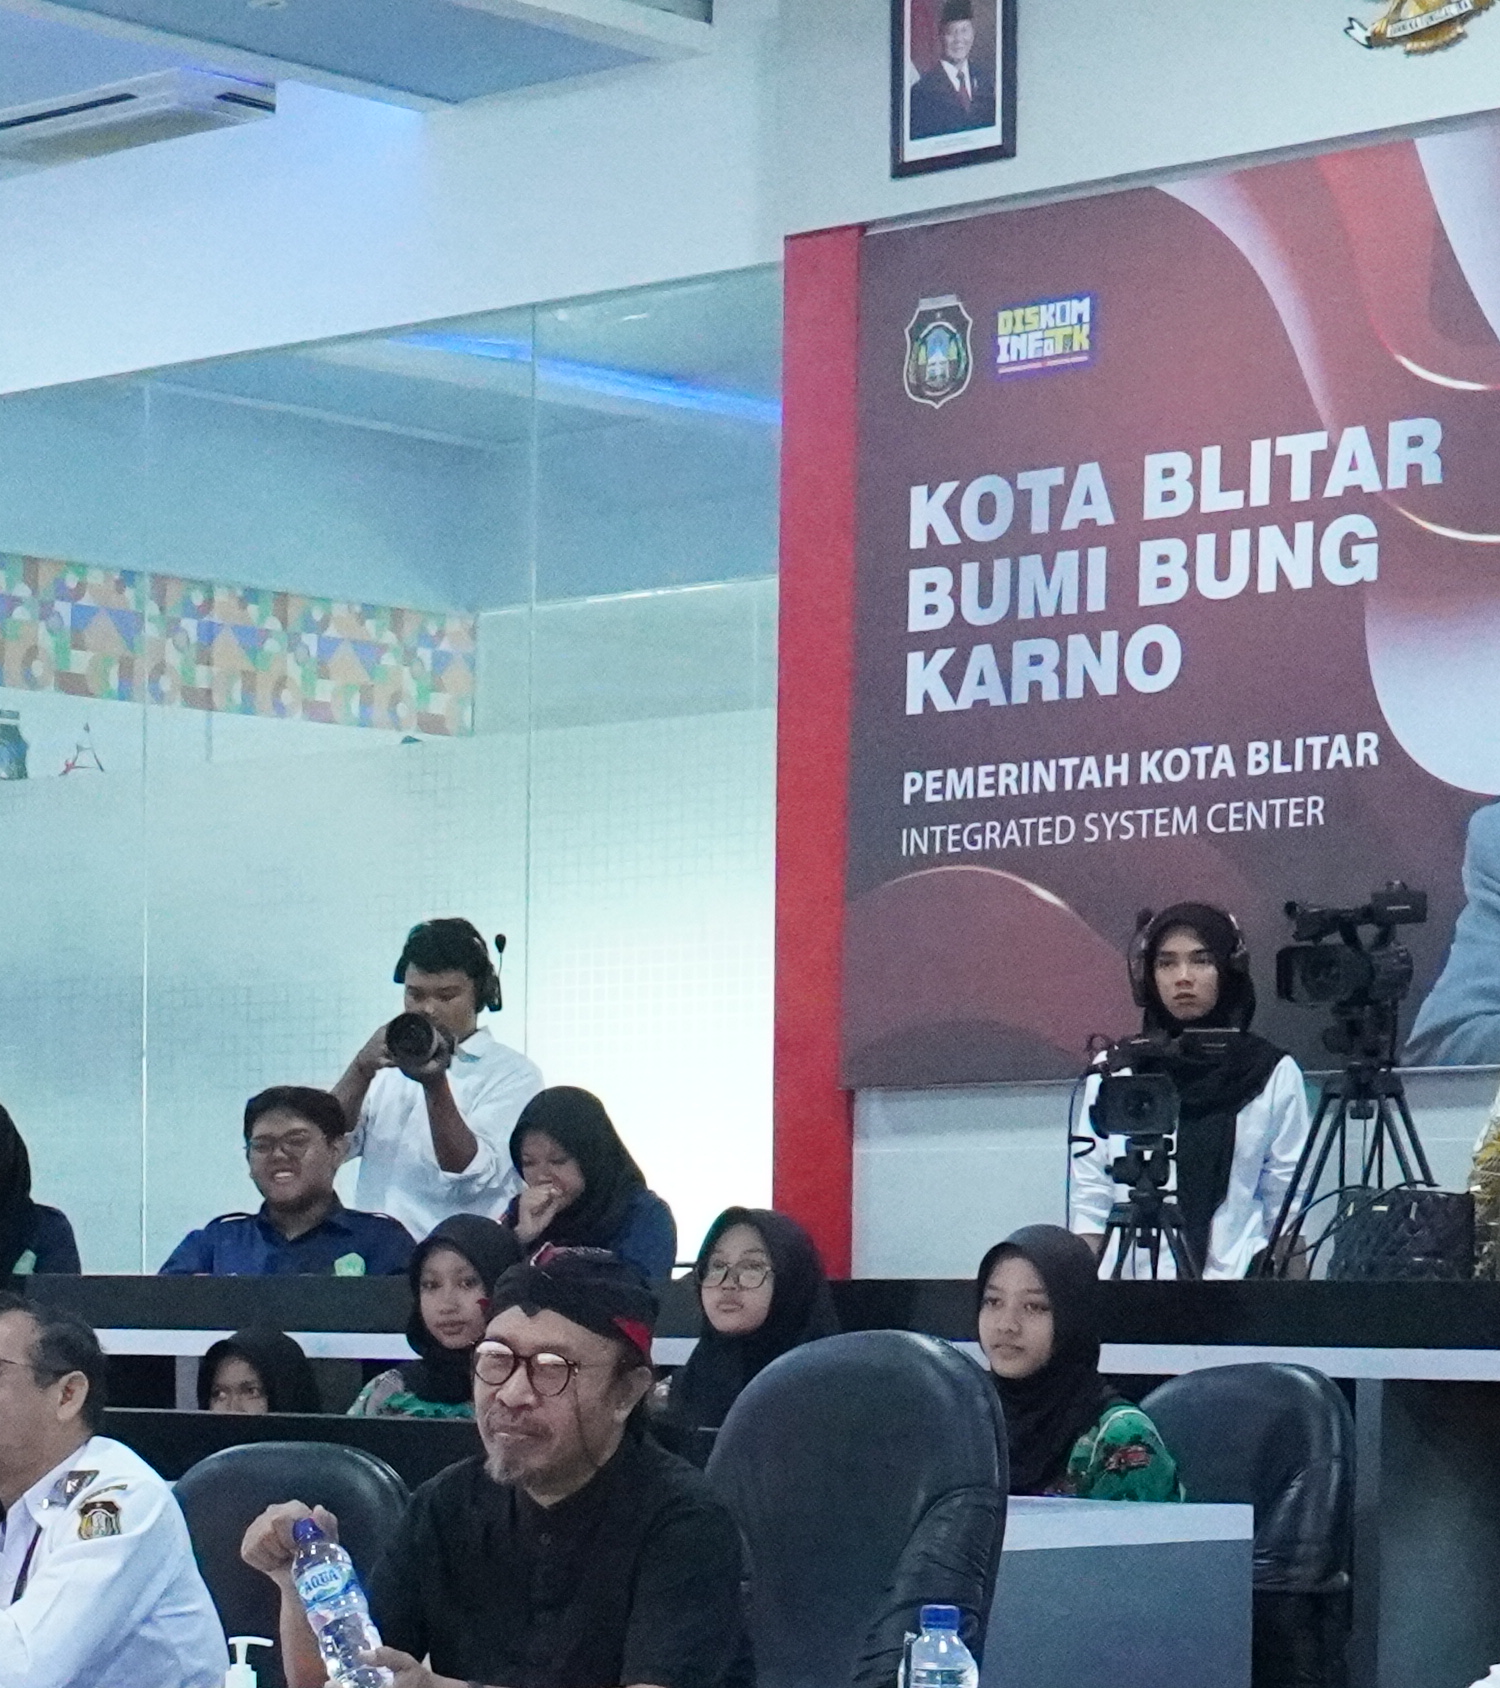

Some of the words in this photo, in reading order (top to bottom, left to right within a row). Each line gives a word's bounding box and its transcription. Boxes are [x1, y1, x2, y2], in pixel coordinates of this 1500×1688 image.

[997, 297, 1091, 335] DISKOM
[908, 461, 1115, 549] KOTA
[1143, 417, 1443, 520] BLITAR
[907, 546, 1107, 632] BUMI
[1138, 513, 1379, 606] BUNG
[905, 623, 1182, 715] KARNO
[902, 753, 1129, 804] PEMERINTAH
[1139, 743, 1237, 784] KOTA
[1247, 731, 1379, 776] BLITAR
[901, 814, 1076, 856] INTEGRATED
[1083, 805, 1198, 843] SYSTEM
[1206, 795, 1325, 834] CENTER
[303, 1567, 339, 1596] AQUA
